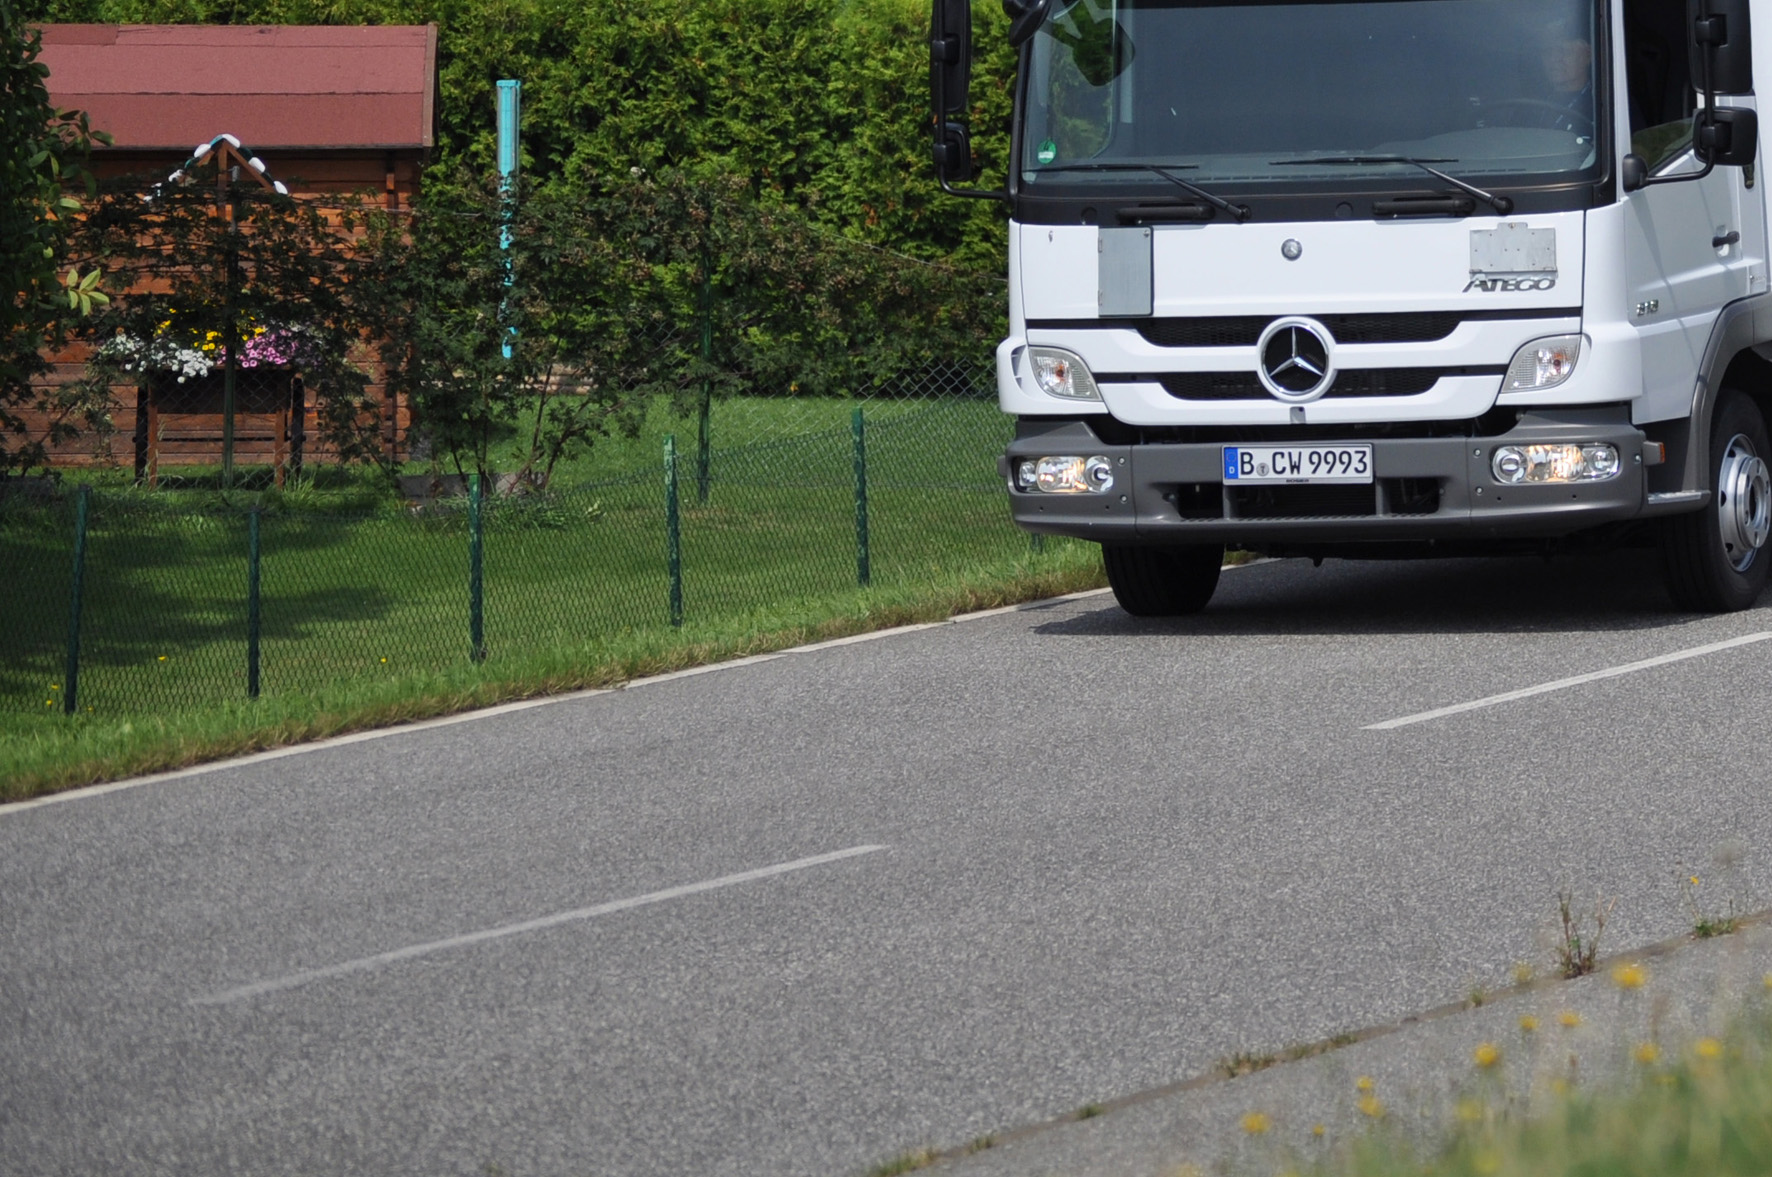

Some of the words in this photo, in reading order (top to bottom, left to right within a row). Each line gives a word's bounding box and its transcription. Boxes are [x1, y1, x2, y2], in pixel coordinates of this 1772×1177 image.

[1462, 273, 1556, 293] ATEGO
[1228, 466, 1236, 474] D
[1240, 451, 1255, 475] B
[1272, 451, 1302, 475] CW
[1308, 450, 1368, 474] 9993
